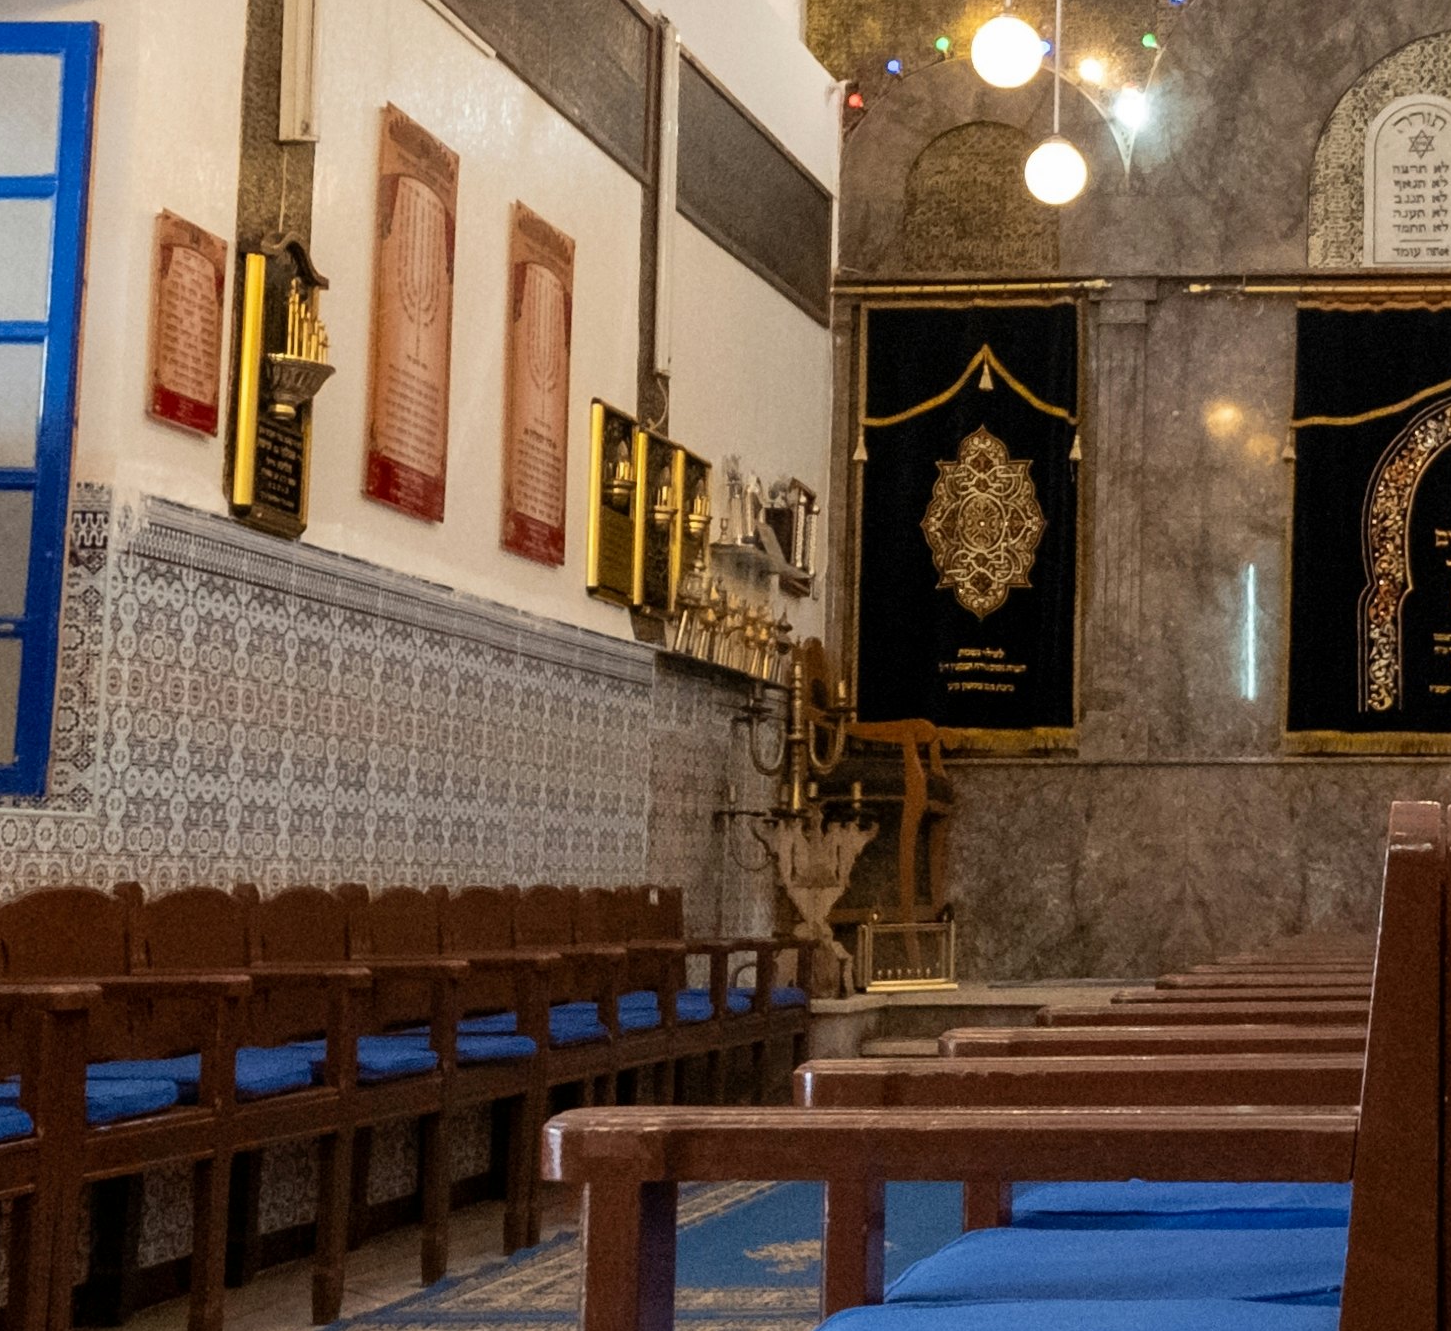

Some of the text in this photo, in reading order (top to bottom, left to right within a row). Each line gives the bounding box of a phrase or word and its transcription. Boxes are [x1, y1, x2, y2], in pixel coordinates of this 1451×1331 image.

[1393, 112, 1447, 133] תורה
[1392, 160, 1449, 174] לא תרצח
[1393, 174, 1448, 191] לא תנאף
[1394, 190, 1448, 204] לא תגנב
[1393, 205, 1448, 220] לא תענה
[1433, 220, 1449, 233] לא
[1392, 247, 1450, 257] אתה עומד
